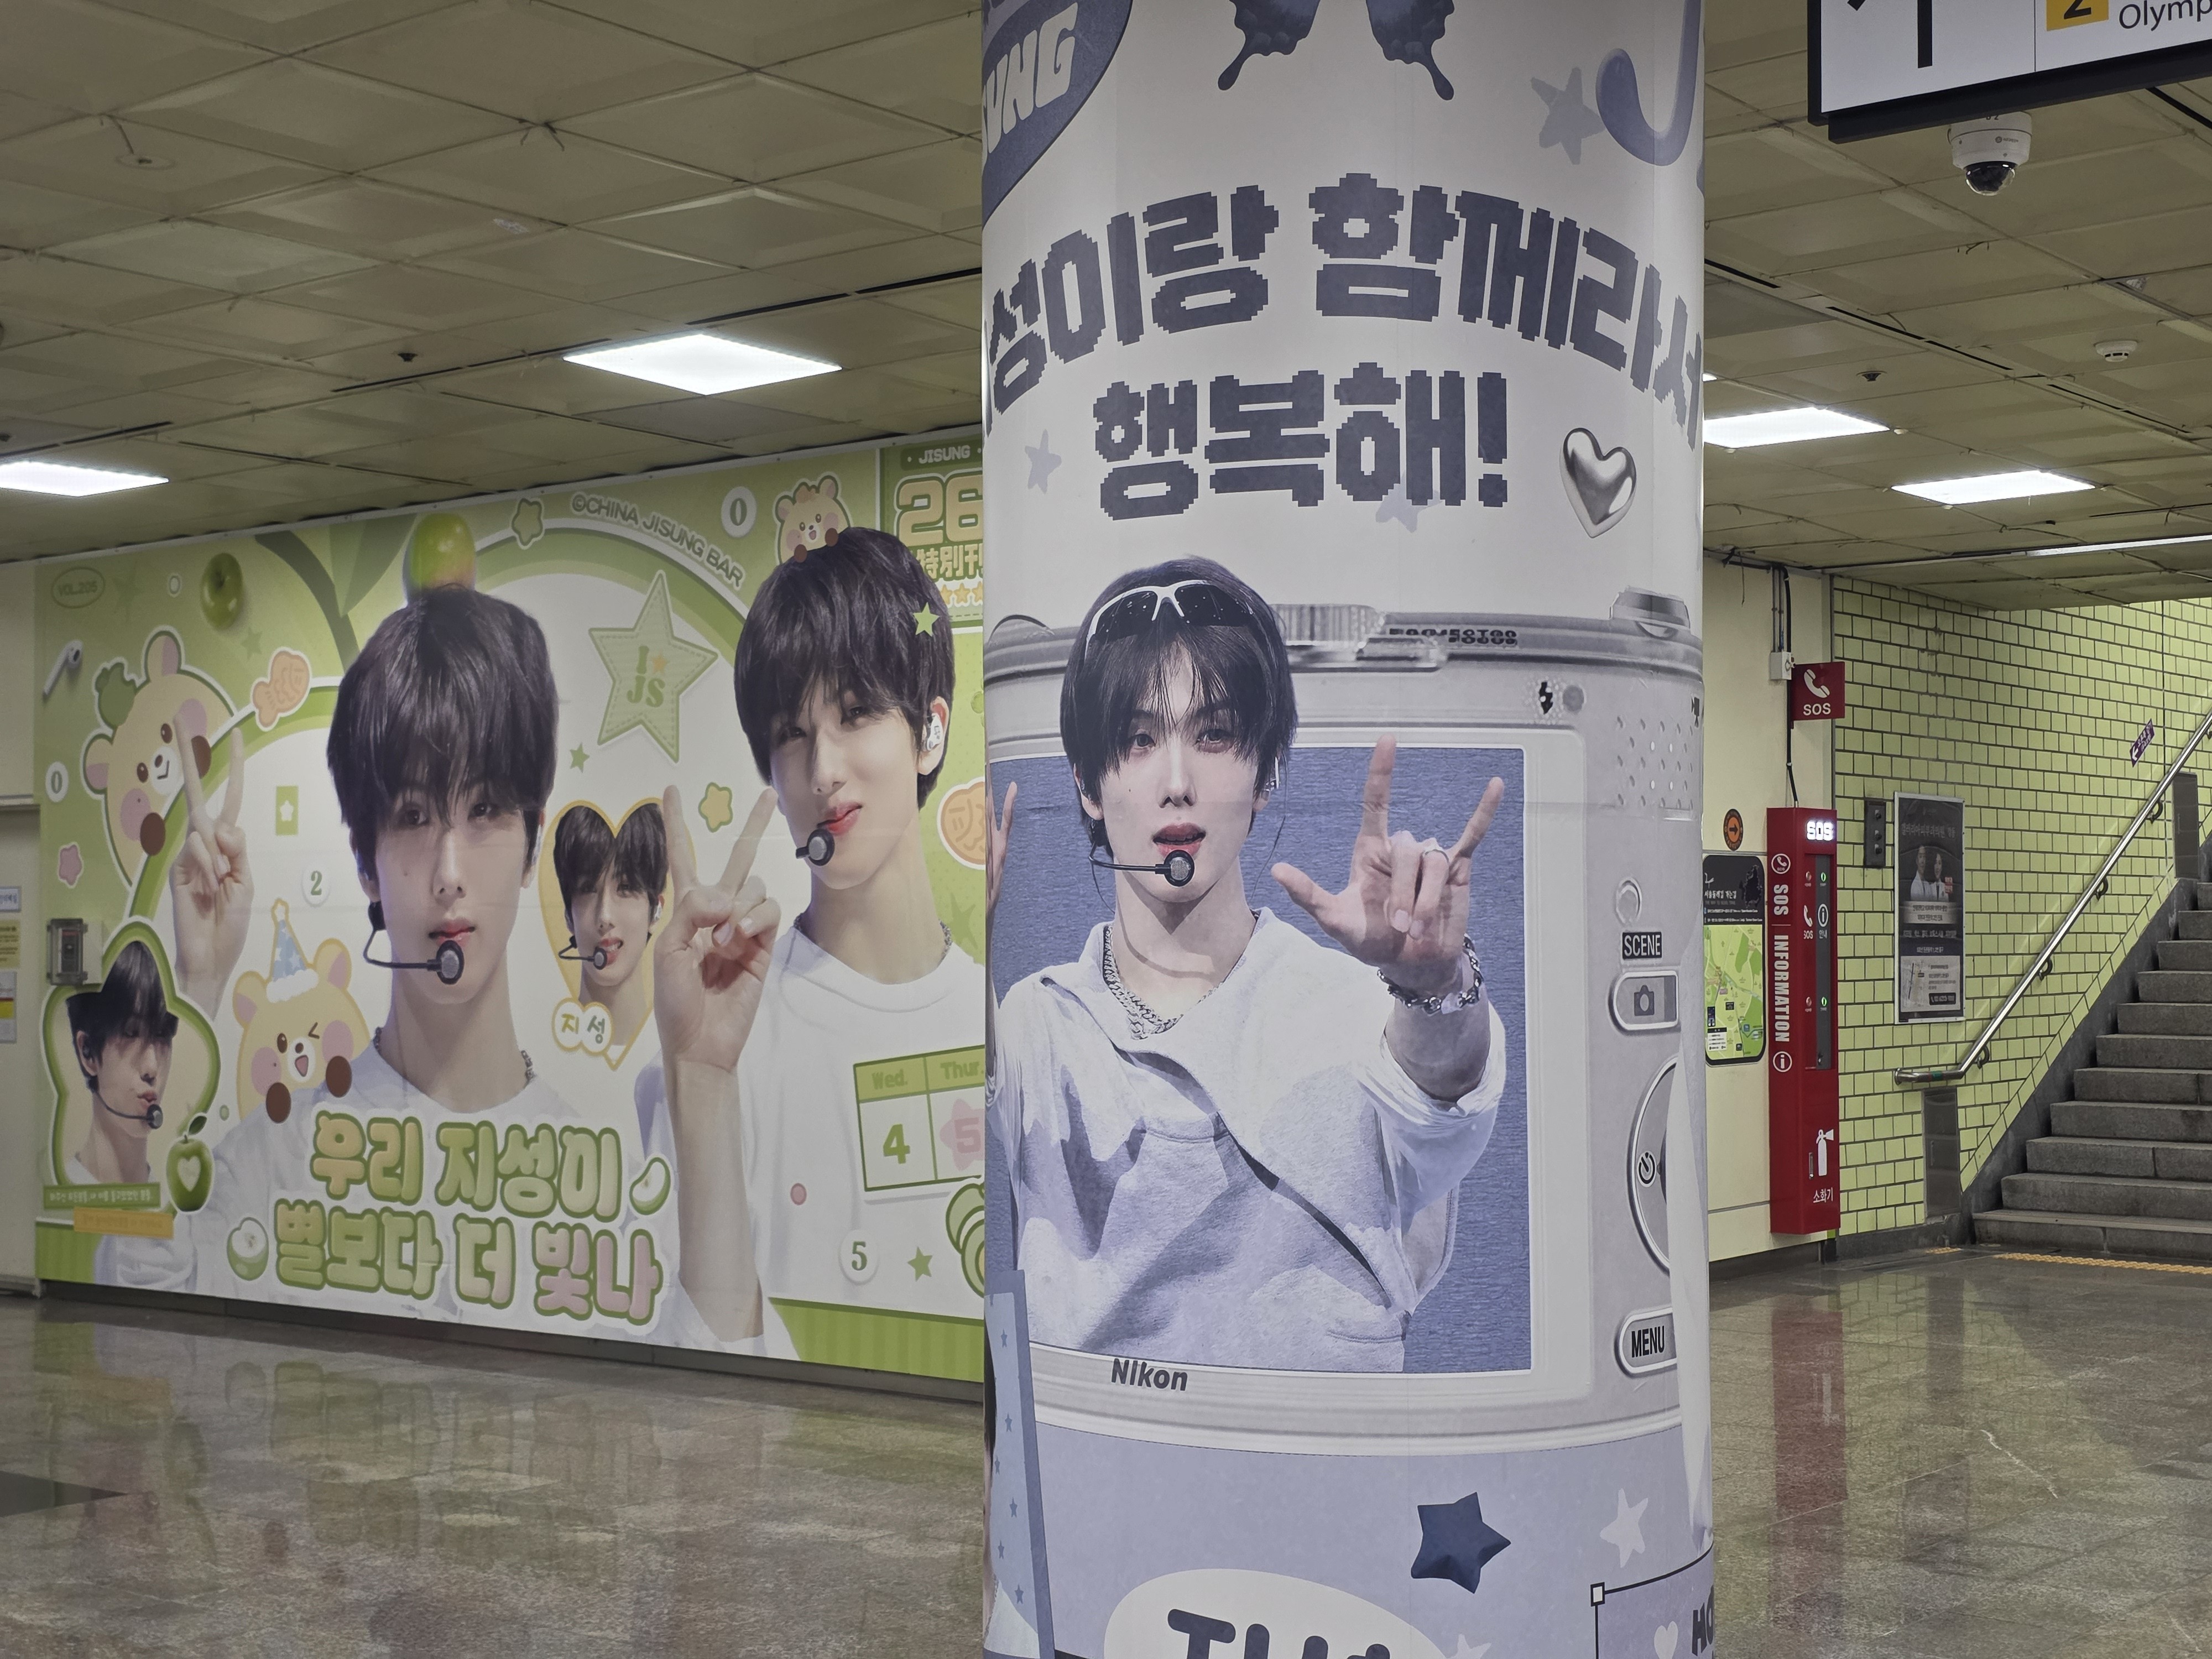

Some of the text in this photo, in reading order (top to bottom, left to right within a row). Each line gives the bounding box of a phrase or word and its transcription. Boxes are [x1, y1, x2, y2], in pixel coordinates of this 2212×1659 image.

[982, 173, 1702, 452] 성이랑 함께라서
[919, 445, 971, 463] JISUNG
[1093, 362, 1507, 520] 행복해!
[643, 515, 706, 558] JISUNG
[706, 547, 743, 587] BAR
[1803, 703, 1832, 716] SOS
[1807, 821, 1834, 841] SOS
[310, 871, 322, 895] 2
[1773, 884, 1789, 915] SOS
[1624, 934, 1661, 957] SCENE
[1803, 930, 1813, 940] SOS
[1774, 935, 1790, 1042] INFORMATION
[872, 1060, 984, 1090] Wed. Thur.
[883, 1117, 980, 1165] 4 5
[310, 1109, 623, 1222] 우리 지성이
[1813, 1187, 1833, 1203] 소화기
[274, 1197, 665, 1327] 별보다 더 빛나
[852, 1241, 868, 1271] 5
[1631, 1326, 1665, 1358] MENU
[1111, 1358, 1188, 1391] Nikon
